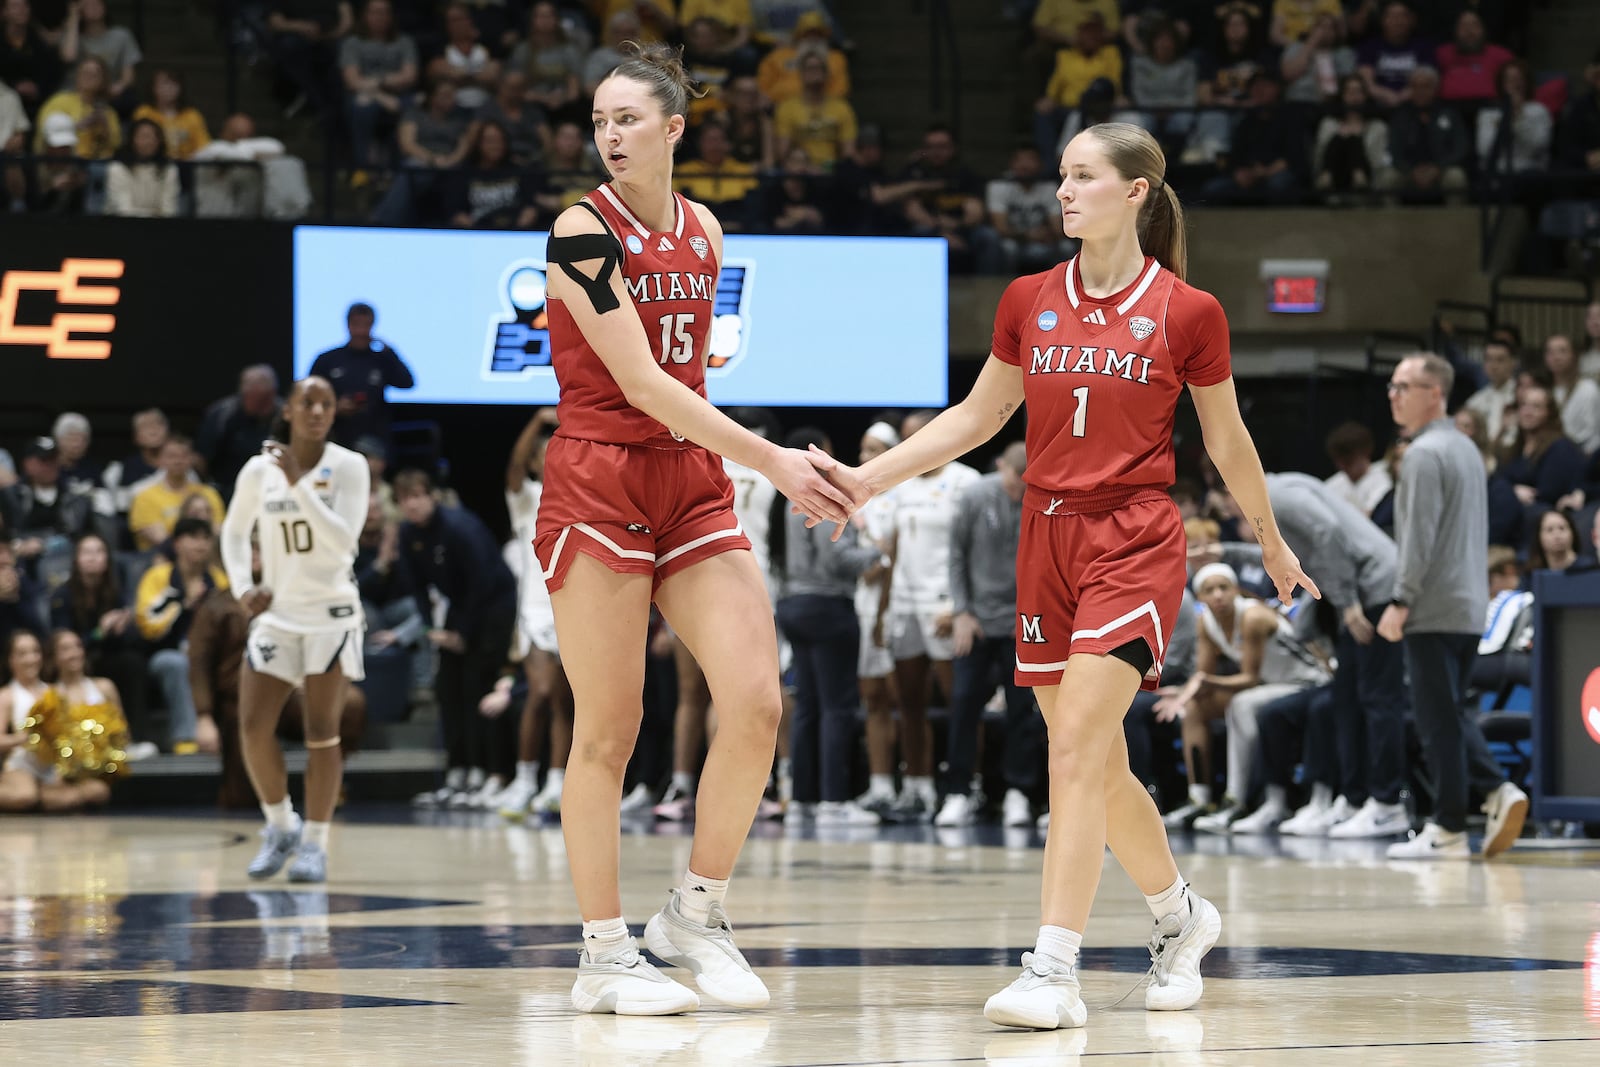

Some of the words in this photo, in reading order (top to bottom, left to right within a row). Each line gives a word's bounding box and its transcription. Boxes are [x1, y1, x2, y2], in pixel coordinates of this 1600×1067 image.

[658, 312, 696, 365] 15
[1029, 345, 1154, 385] MIAMI
[1072, 386, 1090, 438] 1
[280, 520, 313, 555] 10
[1019, 611, 1049, 644] M
